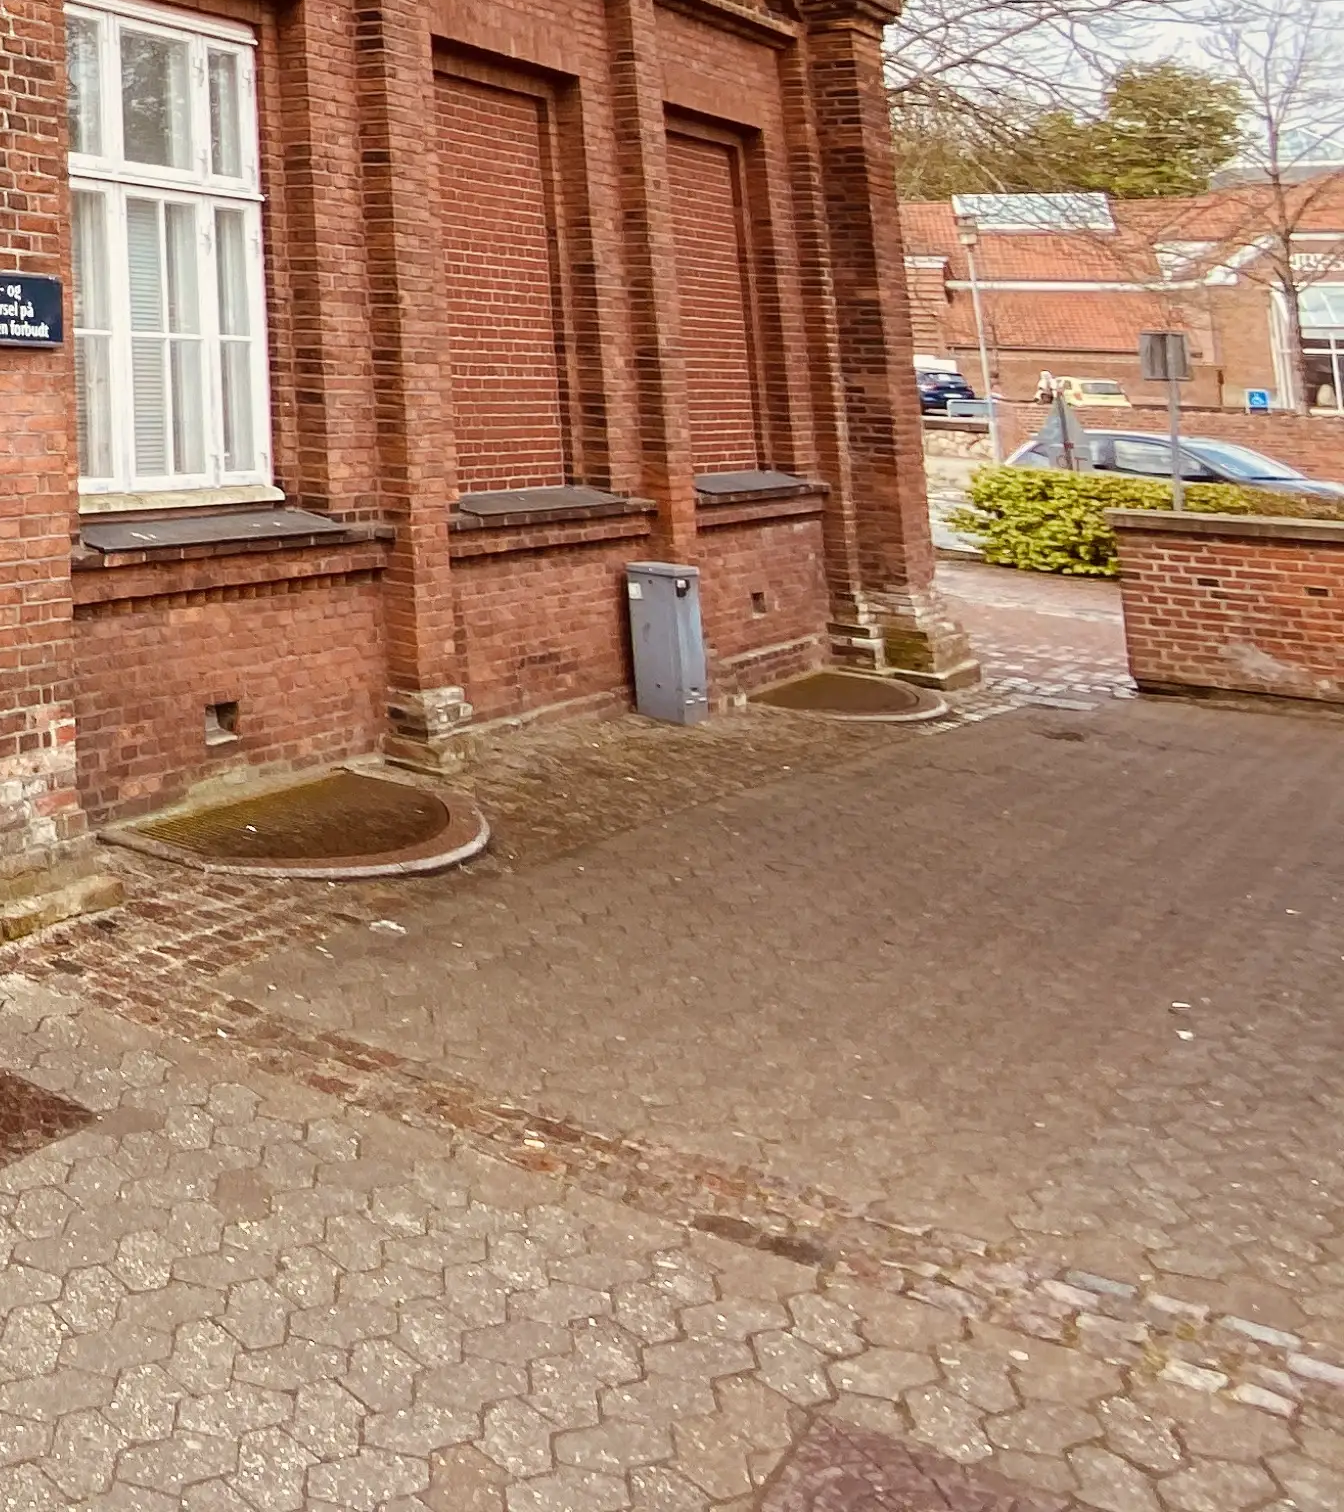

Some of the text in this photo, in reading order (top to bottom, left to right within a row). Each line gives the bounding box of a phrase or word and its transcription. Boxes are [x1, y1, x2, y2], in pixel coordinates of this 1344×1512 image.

[6, 284, 22, 301] og
[19, 301, 34, 321] på
[9, 320, 50, 339] forbudt
